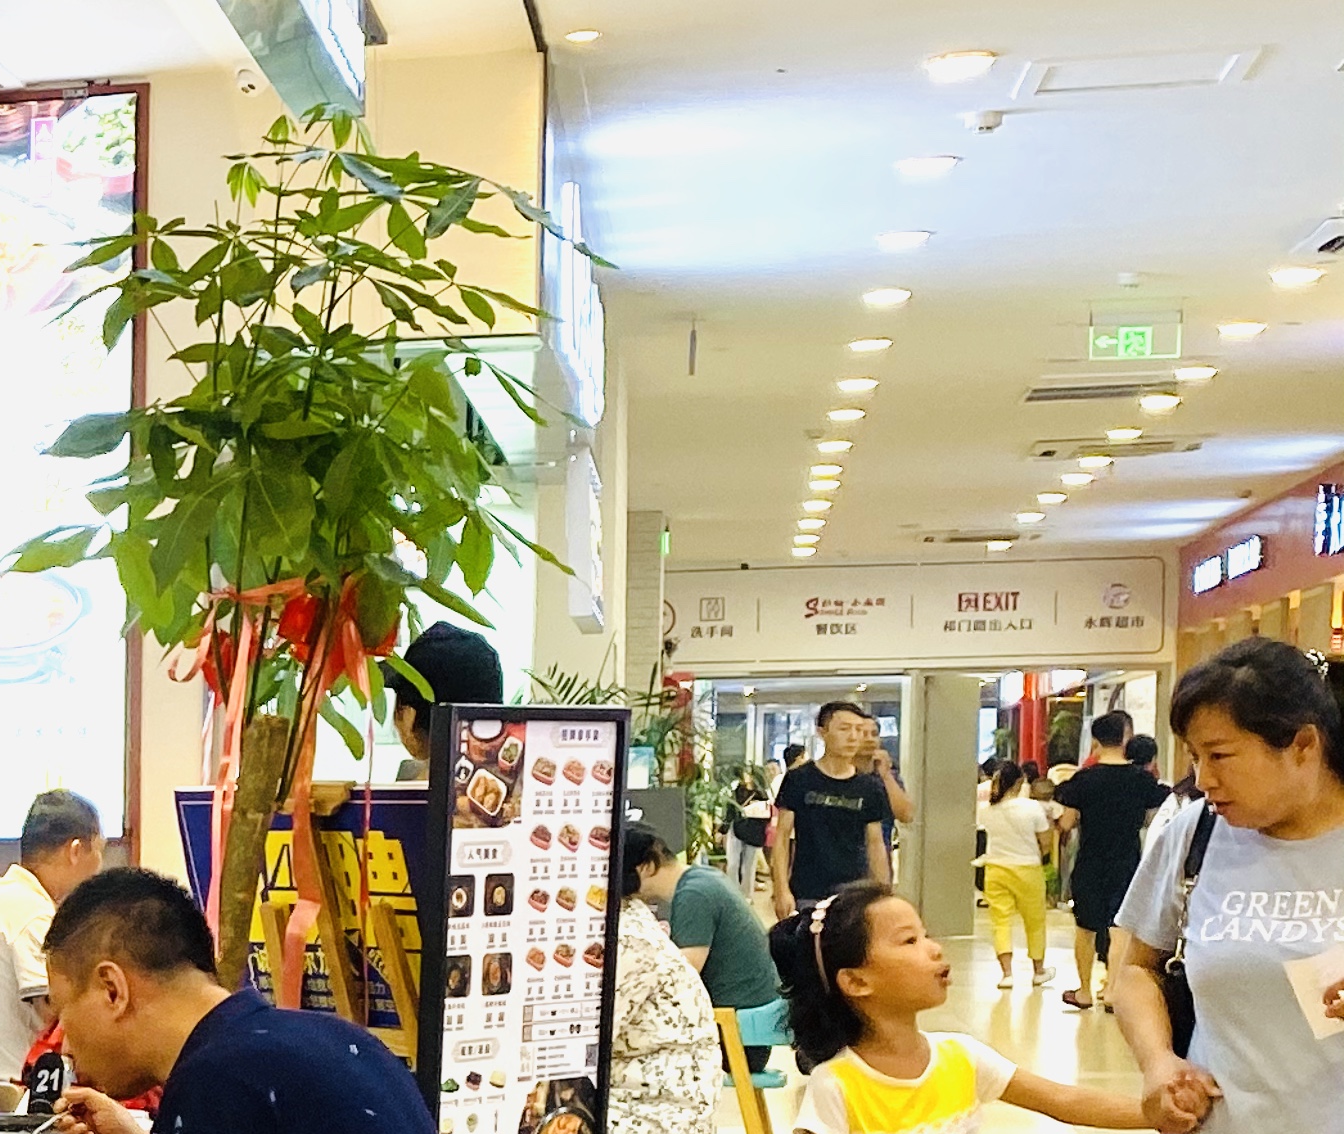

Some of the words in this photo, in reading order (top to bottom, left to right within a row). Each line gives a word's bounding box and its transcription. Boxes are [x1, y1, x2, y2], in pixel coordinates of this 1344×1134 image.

[982, 591, 1020, 612] EXIT
[1221, 888, 1344, 919] GREEN
[35, 1067, 60, 1093] 21
